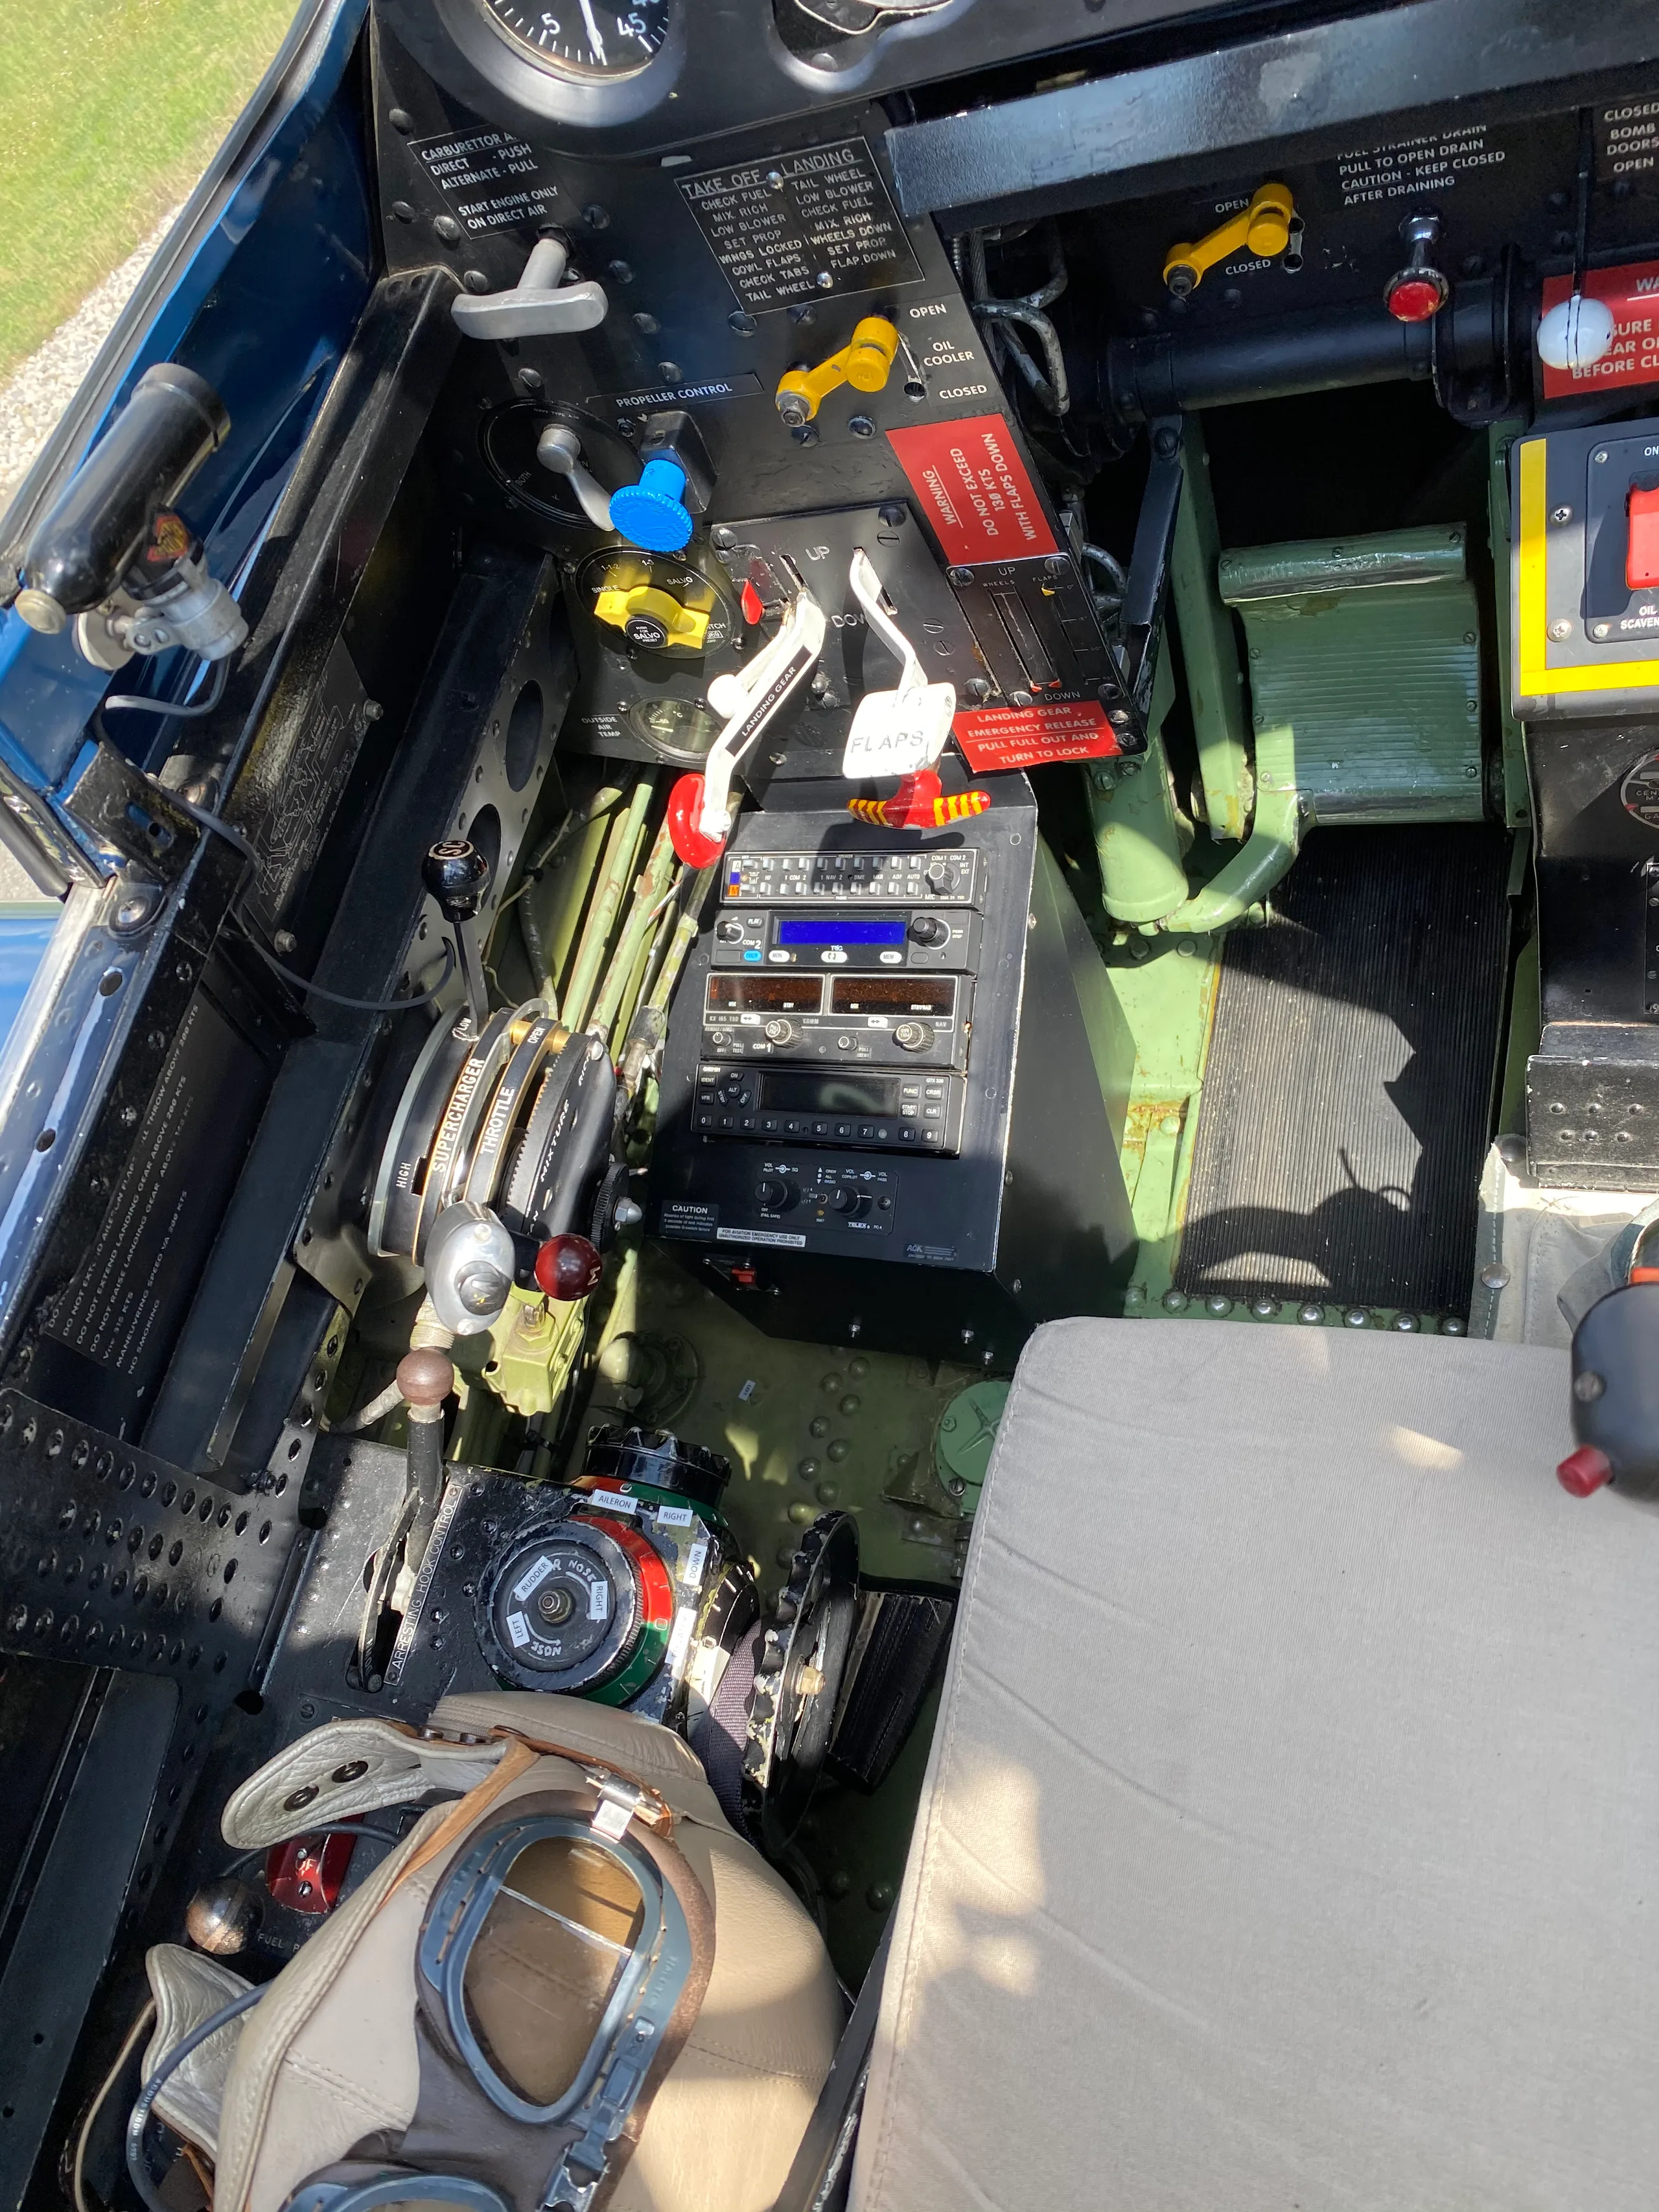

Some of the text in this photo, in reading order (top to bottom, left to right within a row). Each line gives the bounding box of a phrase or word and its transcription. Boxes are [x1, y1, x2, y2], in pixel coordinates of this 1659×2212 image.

[541, 12, 560, 34] 5
[617, 12, 647, 37] 45
[1604, 102, 1659, 122] CLOSED
[1610, 122, 1656, 139] BOMB
[421, 133, 502, 161] CARBURETTOR
[1607, 136, 1659, 155] DOORS
[430, 143, 532, 176] DIRECT PUSH
[782, 149, 855, 176] LANDING
[1339, 138, 1483, 176] PULL TO OPEN DRAIN
[1614, 157, 1654, 172] OPEN
[441, 159, 539, 189] ALTERNATE PULL
[791, 167, 866, 190] TAIL WHEEL
[1341, 150, 1506, 191] CAUTION KEEP CLOSED
[682, 169, 760, 198] TAKE OFF
[795, 181, 874, 205] LOW BLOWER
[1344, 175, 1455, 206] AFTER DRAINING
[458, 185, 559, 216] START ENGINE ONLY
[701, 189, 771, 211] CHECK FUEL
[801, 197, 874, 218] CHECK FUEL
[1214, 198, 1249, 213] OPEN
[467, 204, 548, 229] ON DIRECT AIR
[713, 203, 768, 224] MIX. RICH
[815, 213, 871, 231] MIX. RICH
[710, 213, 786, 238] LOW BLOWER
[810, 222, 892, 246] WHEELS DOWN
[724, 229, 782, 250] SET PROP
[827, 237, 887, 255] SET PROP
[719, 239, 802, 264] WINGS LOCKED
[732, 253, 801, 276] COWL FLAPS
[1225, 259, 1271, 275] CLOSED
[739, 266, 809, 289] CHECK TABS
[745, 280, 815, 302] TAIL WHEEL
[909, 303, 947, 318] OPEN
[932, 340, 955, 351] OIL
[923, 350, 975, 367] COOLER
[1572, 358, 1634, 379] BEFORE
[616, 383, 733, 408] PROPELLER CONTROL
[939, 384, 987, 400] CLOSED
[978, 469, 997, 490] KTS
[981, 433, 1038, 541] WITH FLAPS DOWN
[922, 469, 957, 526] WARNING
[950, 448, 999, 537] DO NOT EXCEED
[805, 546, 830, 561] UP
[667, 576, 693, 585] SALVO
[998, 566, 1016, 576] UP
[591, 585, 620, 594] SINGLE
[1639, 605, 1656, 616] OIL
[741, 666, 796, 737] LANDING GEAR
[1045, 691, 1081, 701] DOWN
[977, 707, 1073, 723] LANDING GEAR
[967, 718, 1096, 738] EMERGENCY RELEASE
[850, 730, 924, 754] FLAPS
[978, 732, 1098, 752] PULL FULL OUT AND
[999, 747, 1089, 764] TURN TO LOCK
[754, 940, 761, 949] 2
[459, 1016, 472, 1031] LOW
[528, 1027, 546, 1044] OPEN
[767, 1043, 771, 1053] 1
[432, 1058, 485, 1173] SUPERCHARGER
[480, 1086, 515, 1154] THROTTLE
[540, 1099, 570, 1183] MIXTURE
[395, 1162, 412, 1188] HIGH
[672, 1205, 708, 1214] CAUTION
[907, 1244, 923, 1253] ACK
[126, 1298, 161, 1375] NO SMOKING
[597, 1495, 632, 1509] AILERON
[663, 1511, 687, 1522] RIGHT
[568, 1560, 597, 1583] NOSE
[689, 1550, 701, 1579] DOWN
[391, 1499, 457, 1670] ARRESTING HOOK CONTROL
[521, 1561, 549, 1594] RUDDER
[595, 1585, 604, 1612] RIGHT
[512, 1620, 525, 1639] LEFT
[530, 1640, 563, 1657] NOSE
[257, 1933, 283, 1949] FUEL
